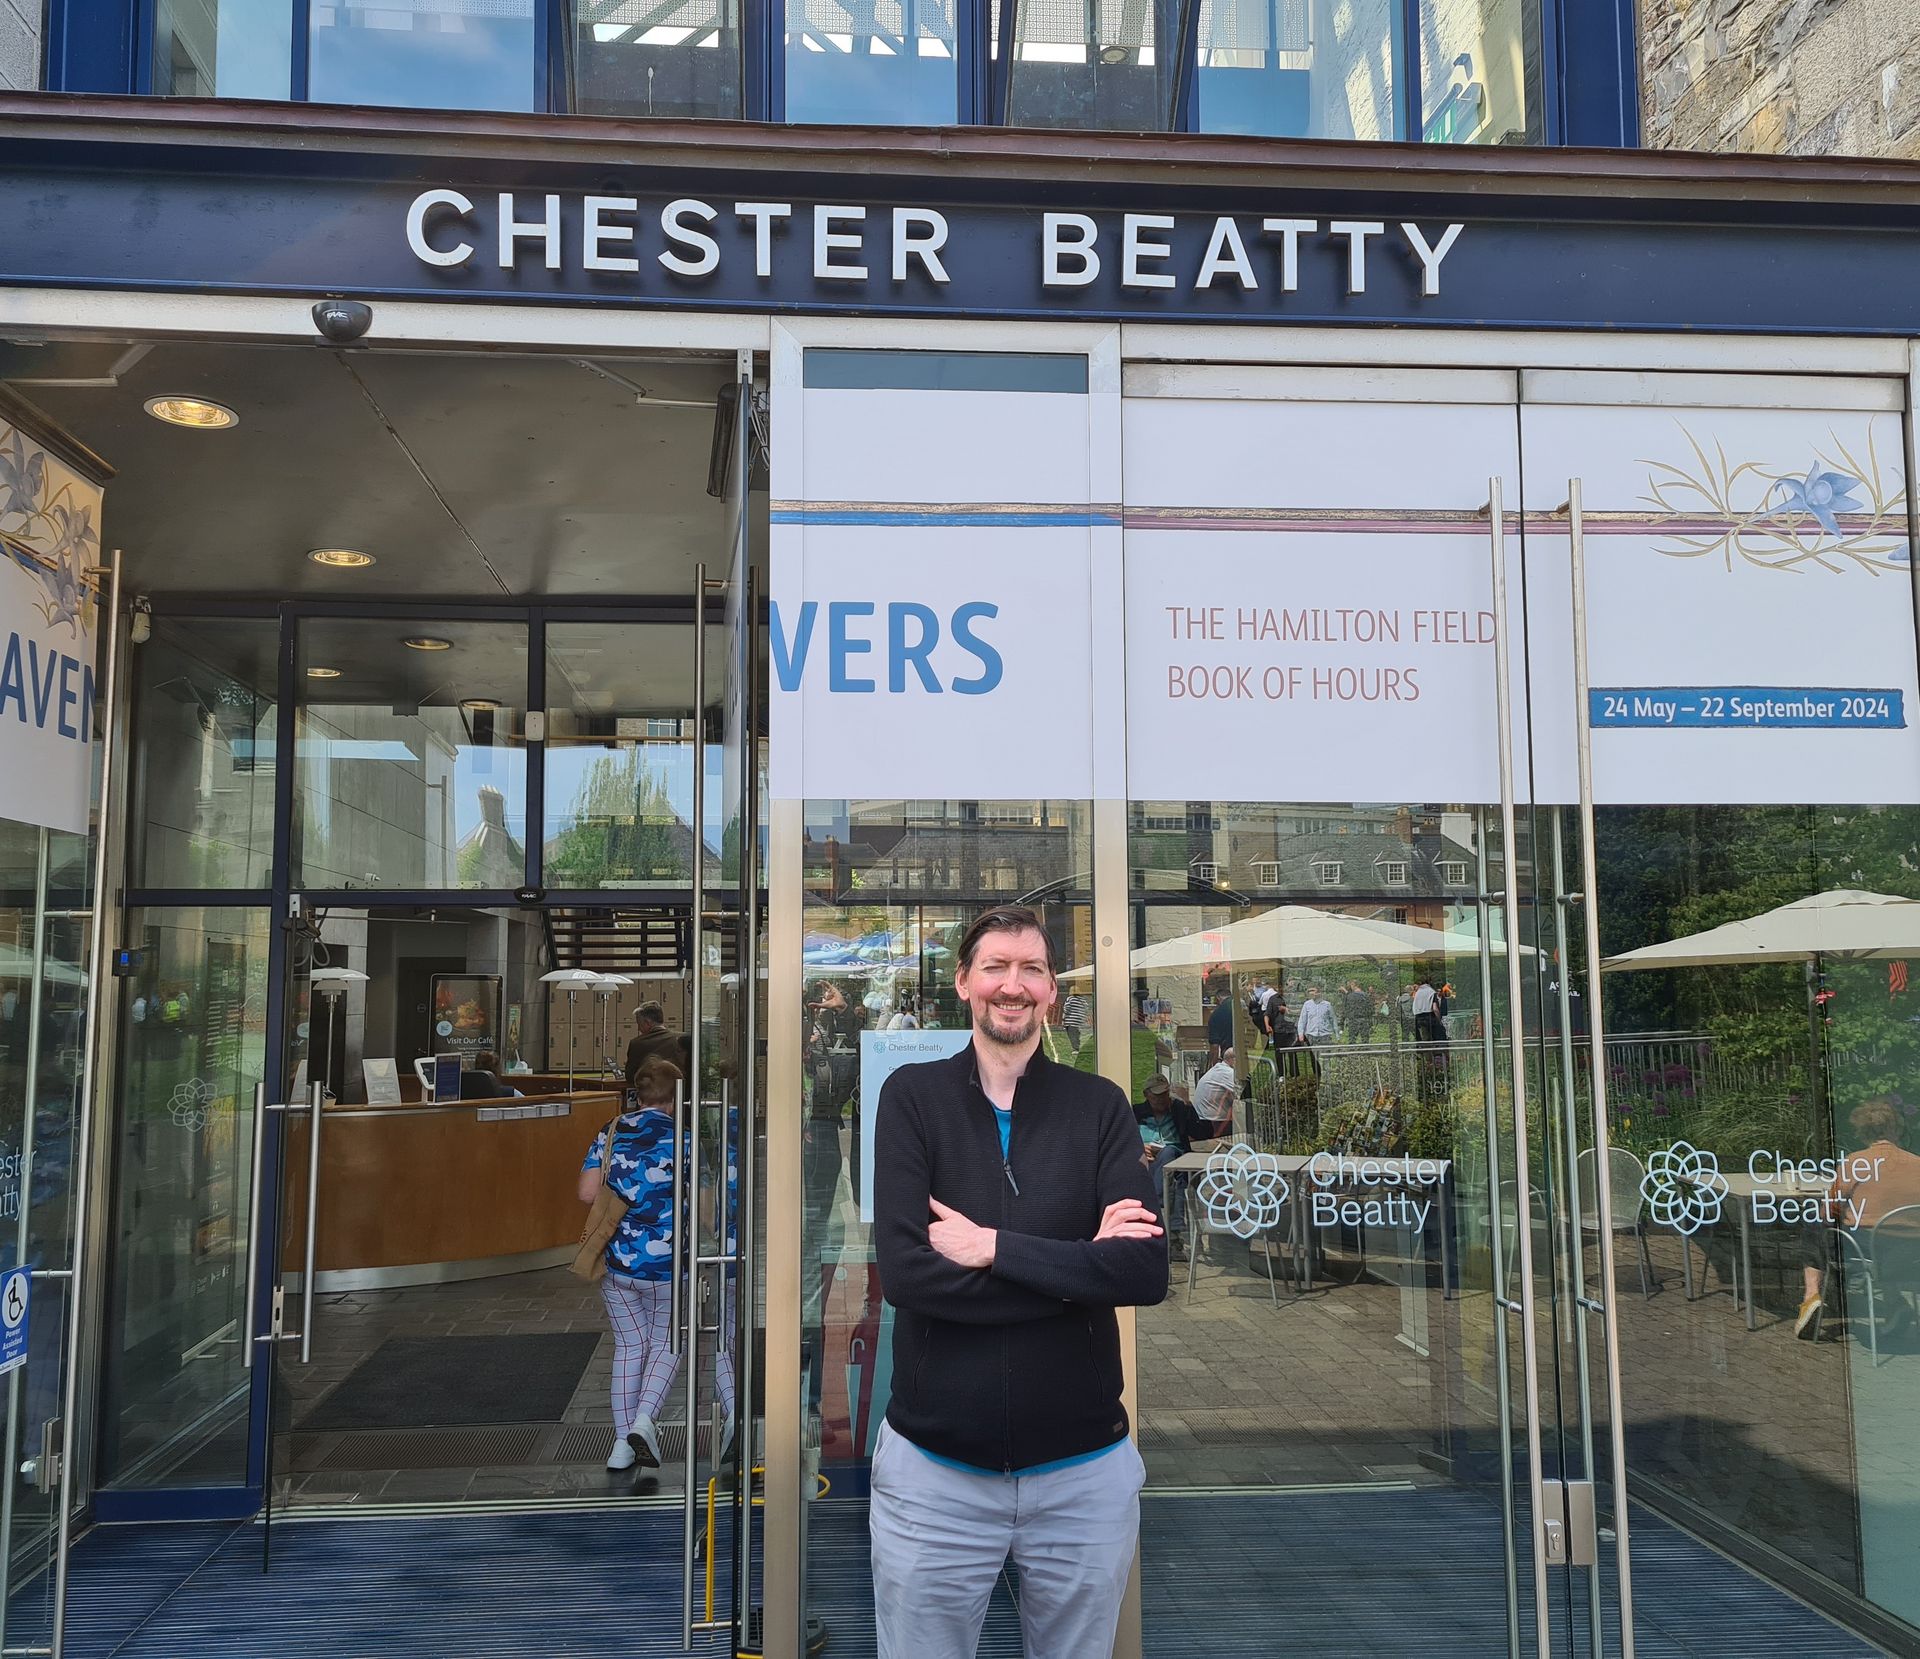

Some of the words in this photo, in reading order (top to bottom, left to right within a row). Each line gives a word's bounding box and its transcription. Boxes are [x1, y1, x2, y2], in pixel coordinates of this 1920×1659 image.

[406, 189, 951, 282] CHESTER
[1042, 212, 1464, 295] BEATTY
[1166, 607, 1225, 640] THE
[1238, 608, 1400, 642] HAMILTON
[1413, 610, 1497, 643] FIELD
[770, 600, 1003, 694] VERS
[1168, 665, 1254, 699] BOOK
[1263, 666, 1303, 700] OF
[1313, 667, 1421, 701] HOURS
[1603, 697, 1628, 718] 24
[1634, 697, 1677, 722] May
[1700, 697, 1725, 718] 22
[1730, 697, 1835, 723] September
[1840, 697, 1889, 719] 2024
[888, 1043, 917, 1052] Chester
[918, 1043, 944, 1053] Beatty
[1309, 1151, 1452, 1186] Chester
[1748, 1149, 1885, 1183] Chester
[1312, 1191, 1431, 1234] Beatty
